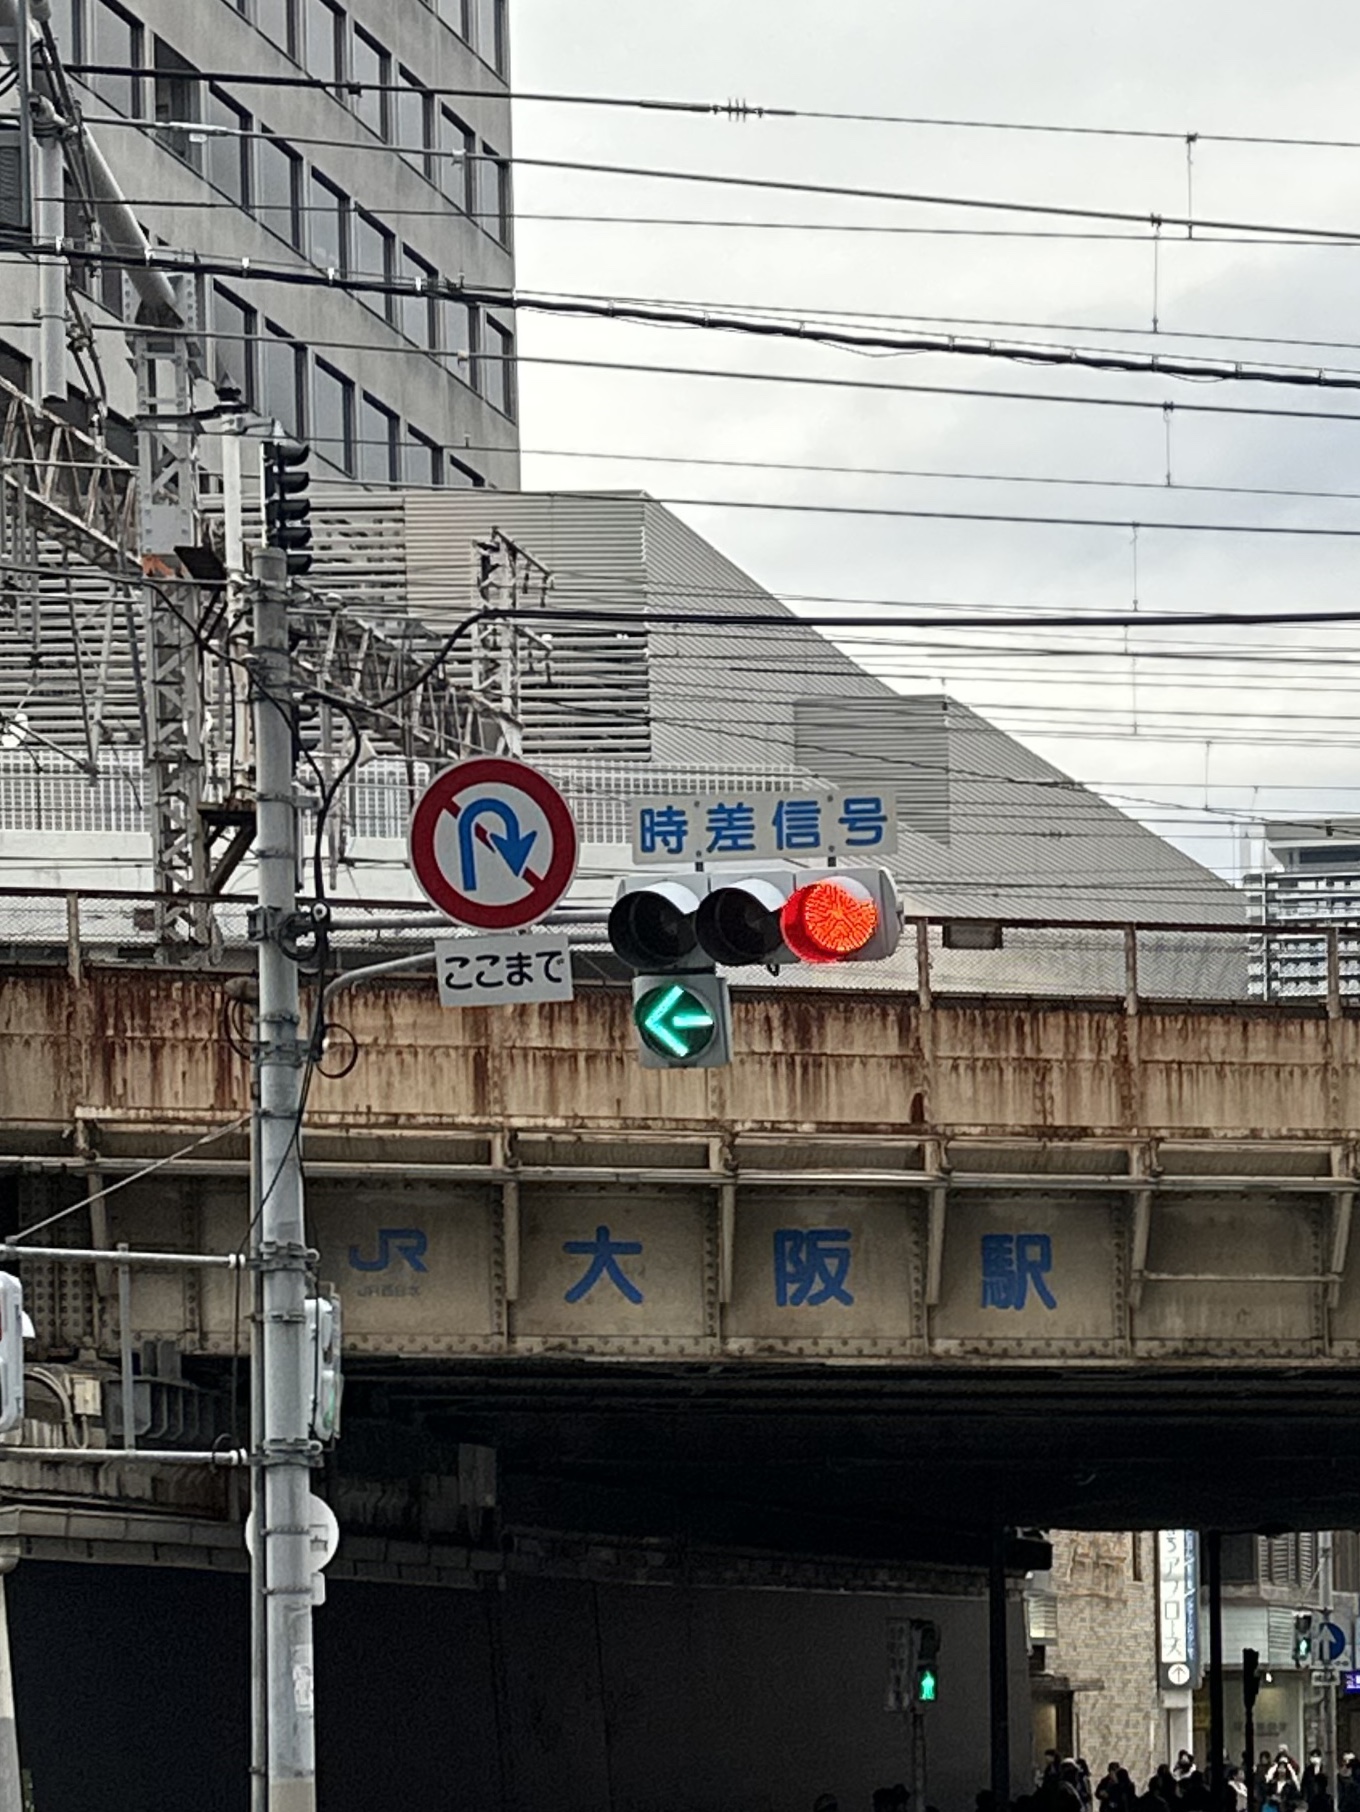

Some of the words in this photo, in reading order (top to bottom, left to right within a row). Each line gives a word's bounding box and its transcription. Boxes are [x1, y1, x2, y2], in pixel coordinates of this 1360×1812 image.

[639, 796, 888, 855] 時差信号
[443, 950, 564, 991] ここまで
[349, 1228, 429, 1272] JR
[563, 1226, 1058, 1310] 大阪駅
